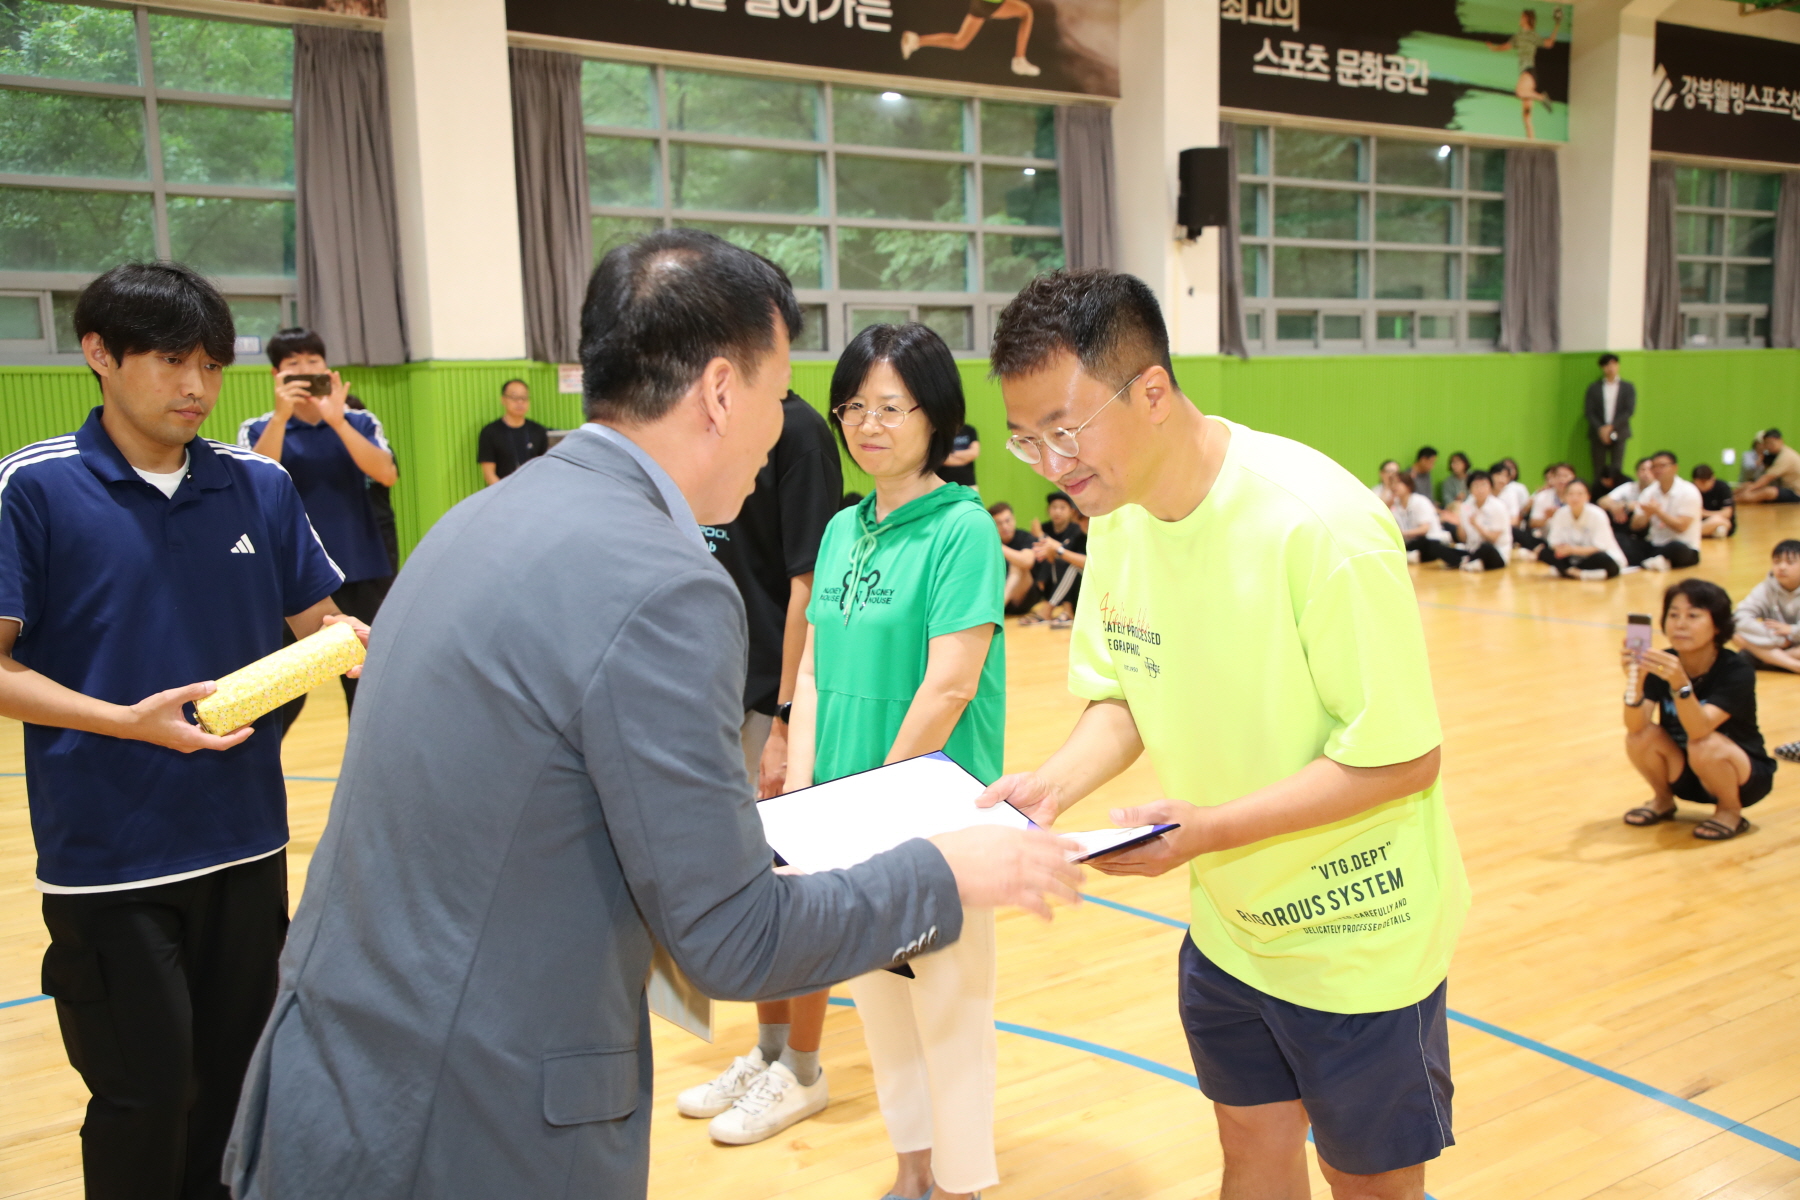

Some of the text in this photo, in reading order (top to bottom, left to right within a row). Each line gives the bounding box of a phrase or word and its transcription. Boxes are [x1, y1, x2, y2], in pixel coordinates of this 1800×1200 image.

[1253, 37, 1429, 96] 스포츠 문화공간
[1310, 841, 1392, 880] "VTG.DEPT"
[1326, 867, 1405, 911] SYSTEM
[1394, 897, 1407, 910] AND
[1303, 924, 1341, 935] DELICATELY
[1342, 922, 1383, 935] PROCESSED
[1382, 912, 1411, 928] DETAILS
